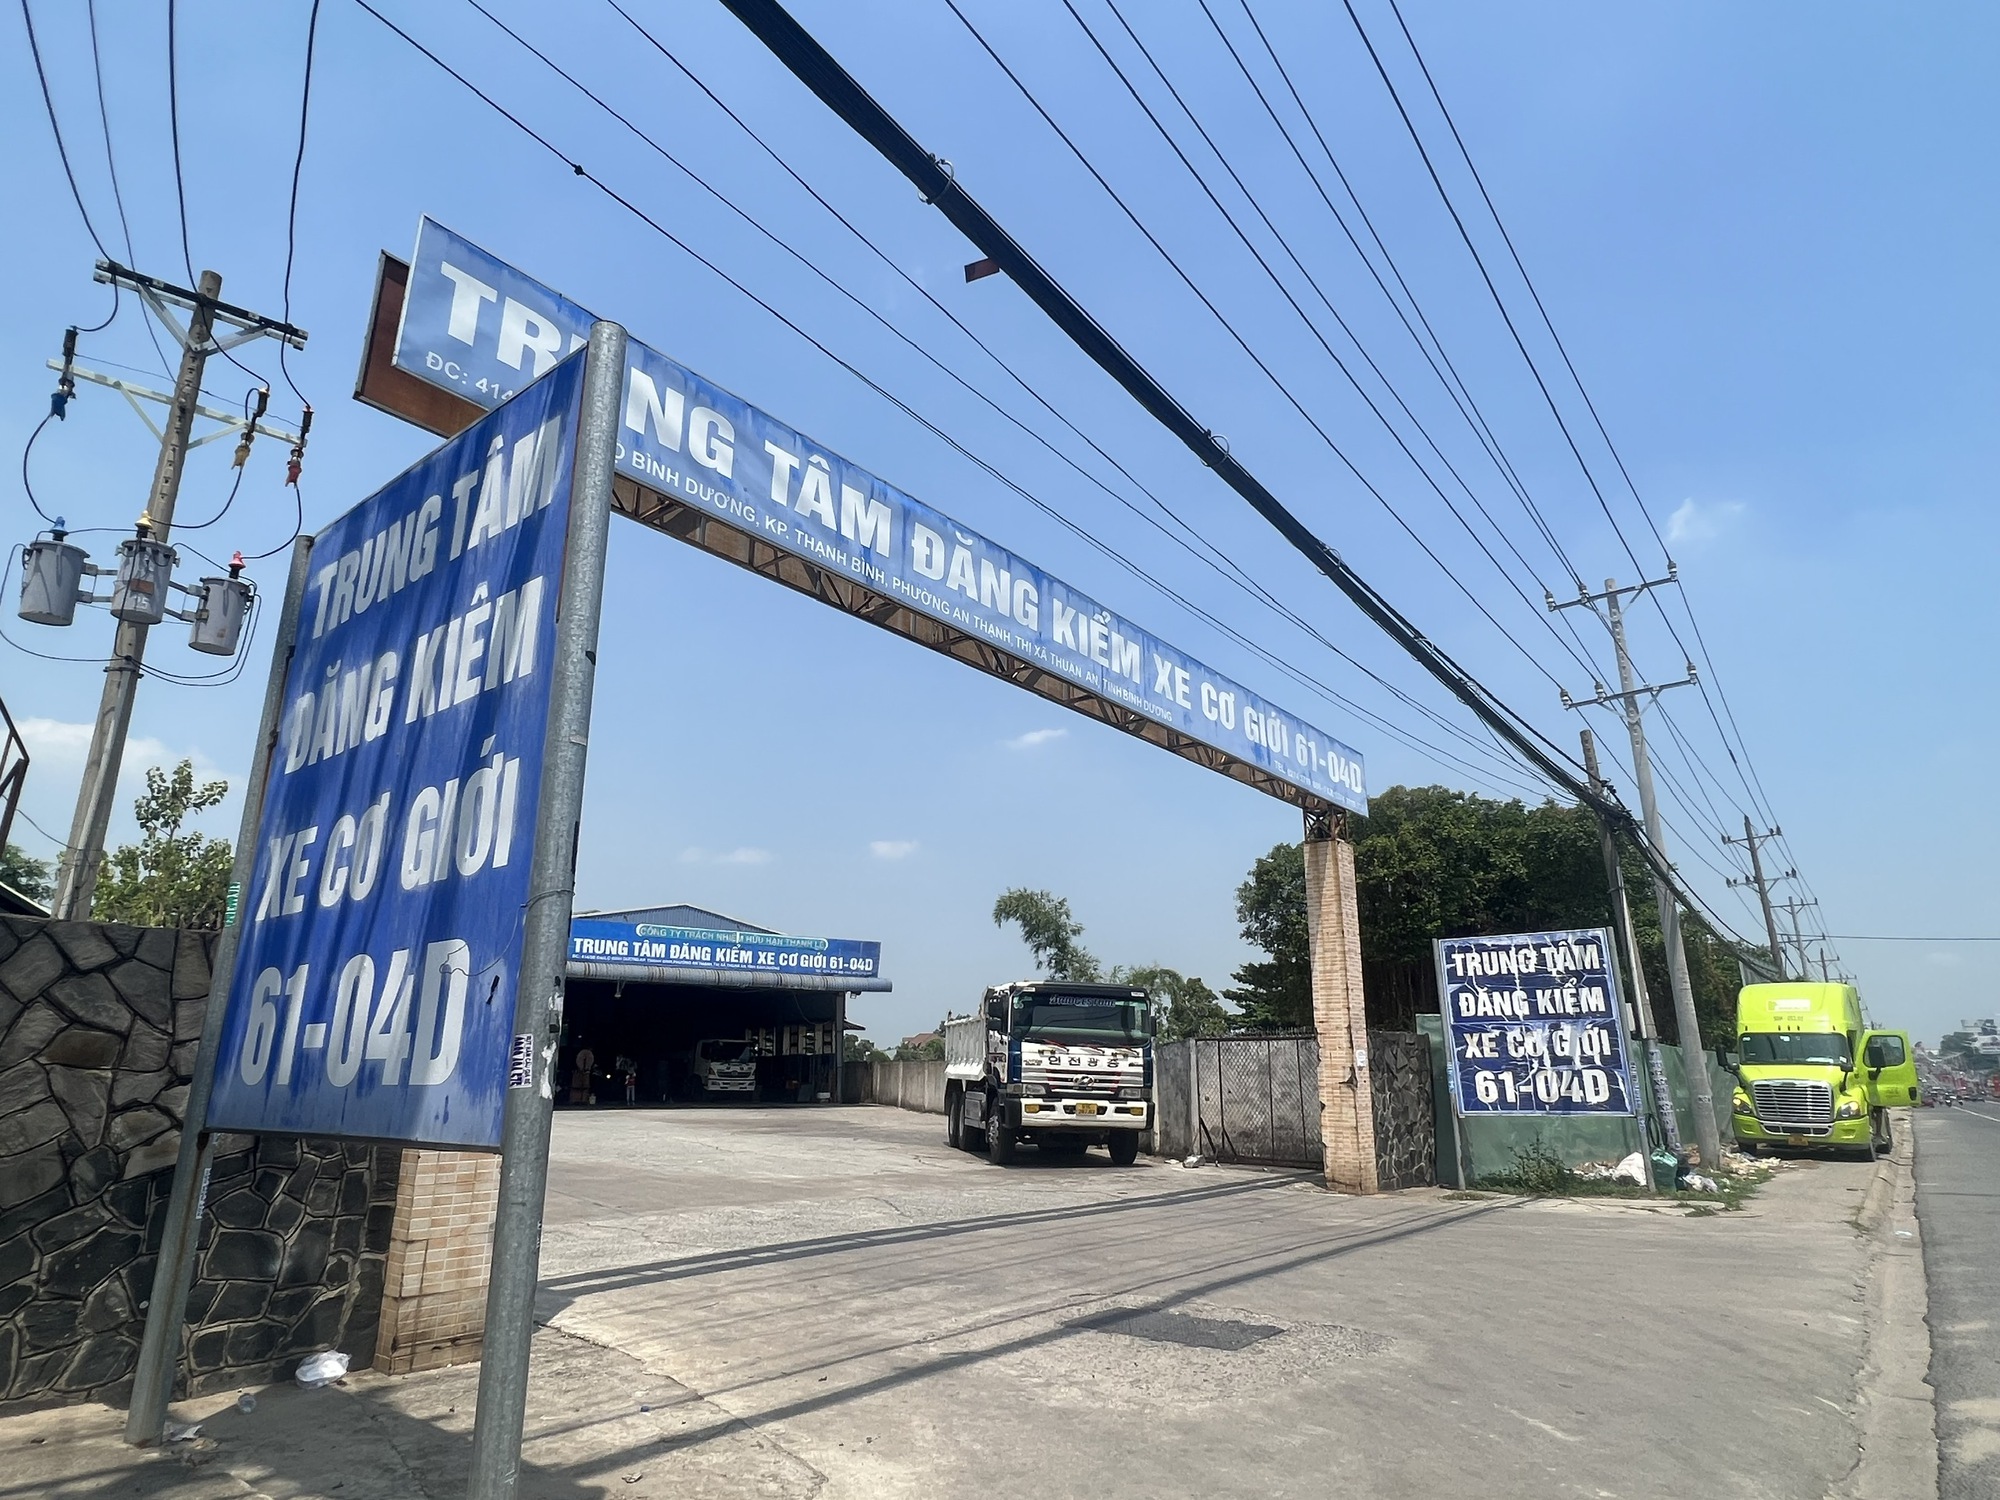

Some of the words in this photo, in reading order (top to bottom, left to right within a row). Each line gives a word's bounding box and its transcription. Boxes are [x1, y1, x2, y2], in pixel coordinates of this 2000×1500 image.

[425, 351, 468, 385] ĐC:
[632, 451, 679, 487] BÌNH
[685, 477, 759, 527] DƯƠNG,
[765, 515, 789, 539] KP.
[795, 528, 847, 566] THẠNH
[851, 556, 888, 588] BÌNH,
[893, 576, 950, 615] PHƯỜNG
[952, 607, 970, 624] AN
[311, 495, 441, 639] TRUNG
[449, 416, 561, 561] TÂM
[440, 261, 736, 479] TRNG
[764, 439, 892, 558] TÂM
[911, 522, 1039, 632] ĐĂNG
[1053, 598, 1140, 684] KIỂM
[1153, 653, 1192, 710] XE
[1200, 682, 1235, 730] CƠ
[1243, 705, 1289, 758] GIỚI
[1295, 733, 1363, 794] 61-04D
[255, 826, 318, 921] XE
[319, 791, 390, 907] CƠ
[401, 734, 519, 890] GIỚI
[640, 925, 667, 937] CÔNG
[669, 929, 682, 938] TY
[573, 938, 628, 956] TRUNG
[632, 939, 665, 958] TÂM
[669, 942, 711, 961] ĐĂNG
[716, 944, 753, 964] KIỂM
[757, 951, 775, 965] XE
[778, 952, 799, 967] CƠ
[800, 951, 827, 969] GIỚI
[829, 957, 873, 971] 61-04D
[1451, 948, 1537, 978] TRUNG
[1541, 940, 1600, 971] TÂM
[240, 938, 470, 1088] 61-04D
[1458, 987, 1530, 1017] ĐĂNG
[1536, 977, 1606, 1015] KIỂM
[1464, 1031, 1499, 1059] XE
[1475, 1070, 1610, 1104] 61-04D
